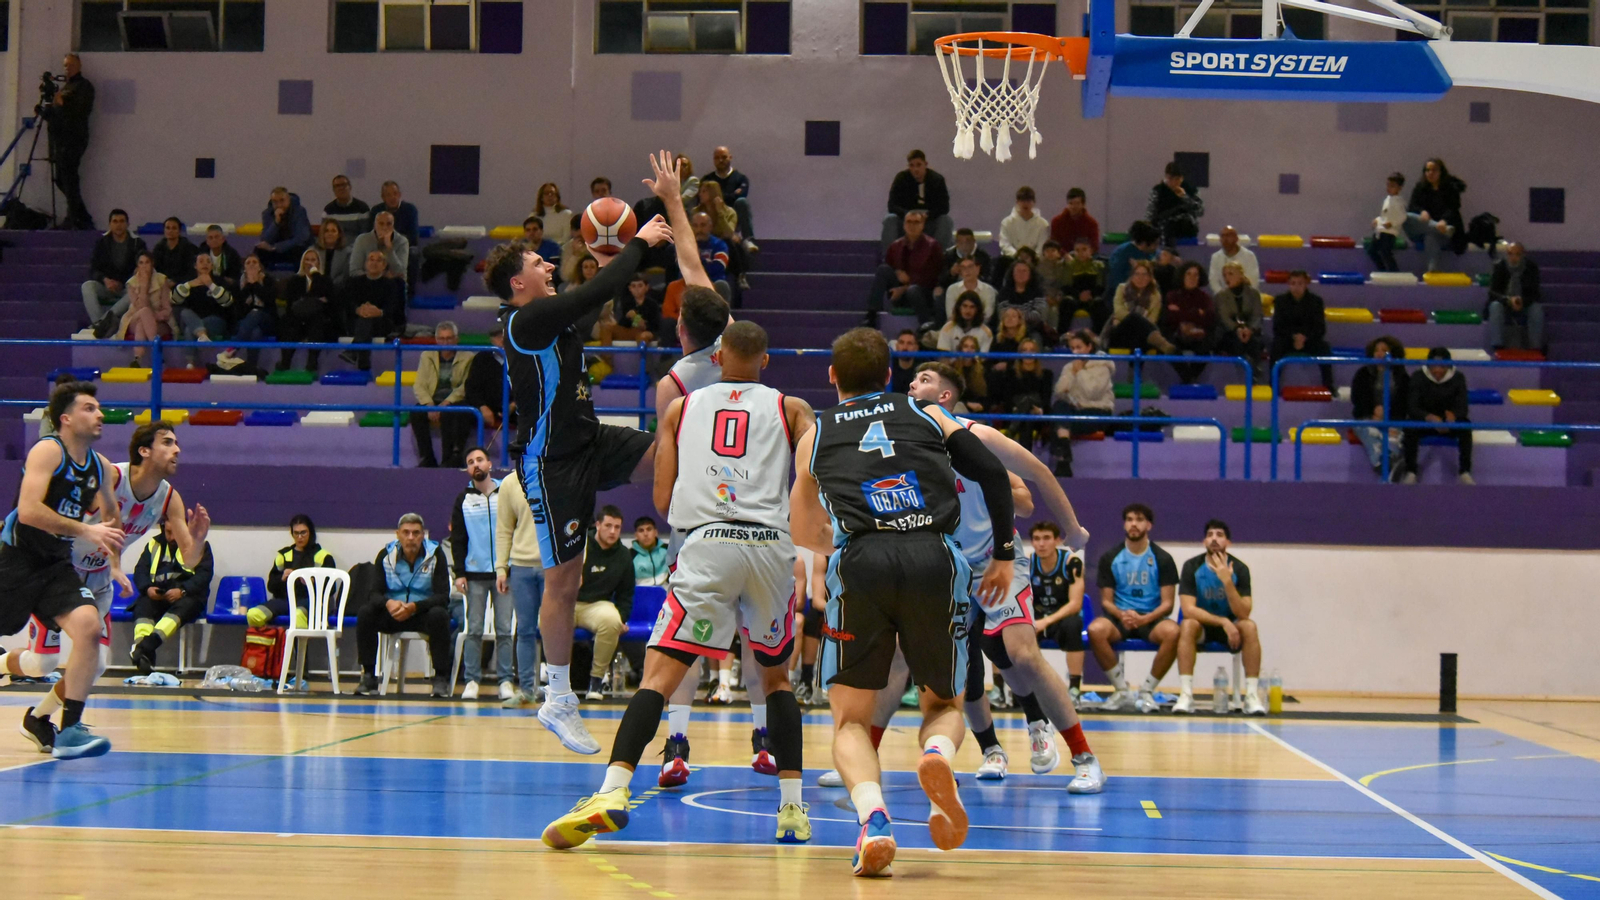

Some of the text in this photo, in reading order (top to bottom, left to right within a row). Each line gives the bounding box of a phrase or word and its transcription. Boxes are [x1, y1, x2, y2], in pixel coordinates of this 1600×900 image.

[1170, 51, 1348, 77] SPORT SYSTEM
[834, 402, 895, 424] FURLÁN
[711, 408, 751, 460] 0
[857, 420, 896, 459] 4
[869, 488, 920, 513] UBAGO
[703, 528, 780, 541] FITNESS PARK
